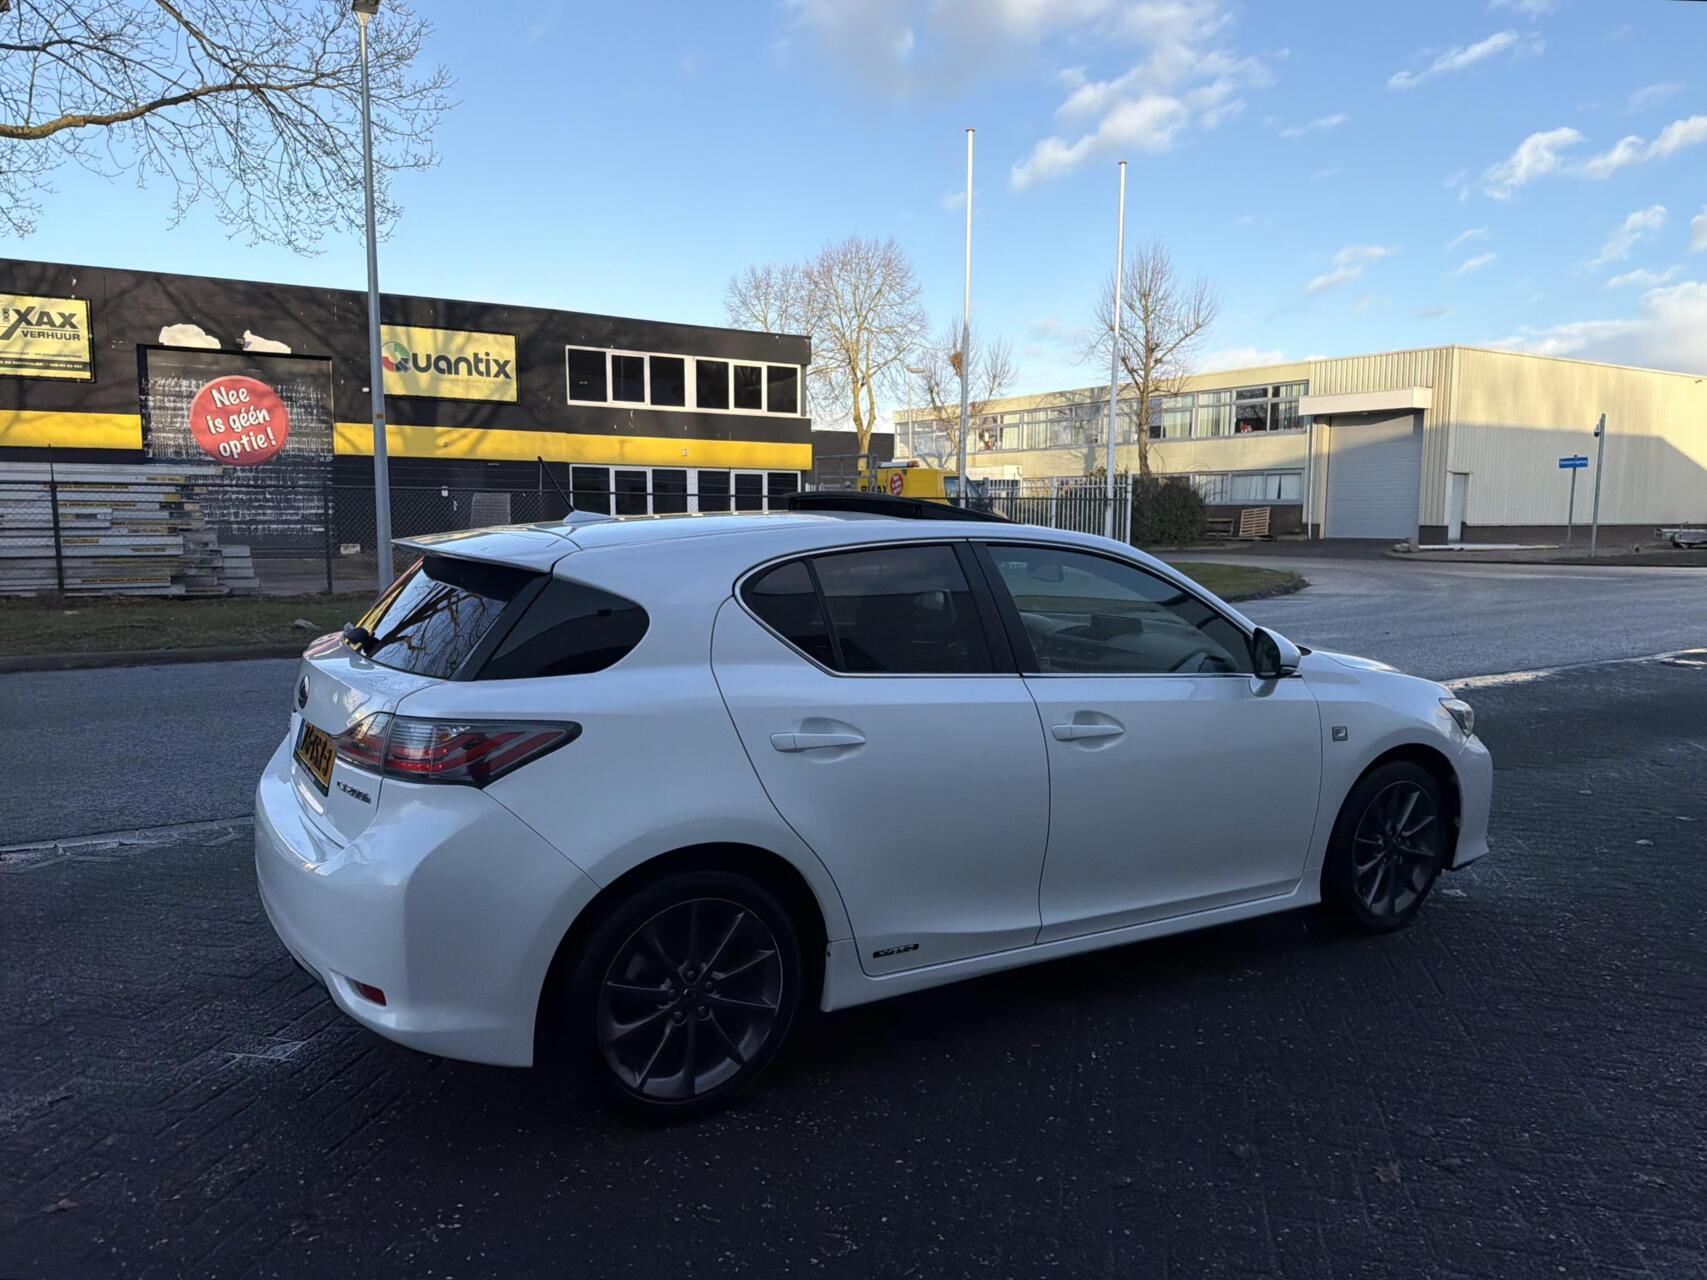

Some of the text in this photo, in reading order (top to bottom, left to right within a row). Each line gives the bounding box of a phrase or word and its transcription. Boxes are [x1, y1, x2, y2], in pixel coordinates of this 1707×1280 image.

[21, 330, 80, 341] VERHUUR
[381, 341, 512, 379] Quantix
[210, 385, 250, 408] Nee
[206, 405, 270, 434] is géén
[218, 427, 277, 459] optie!
